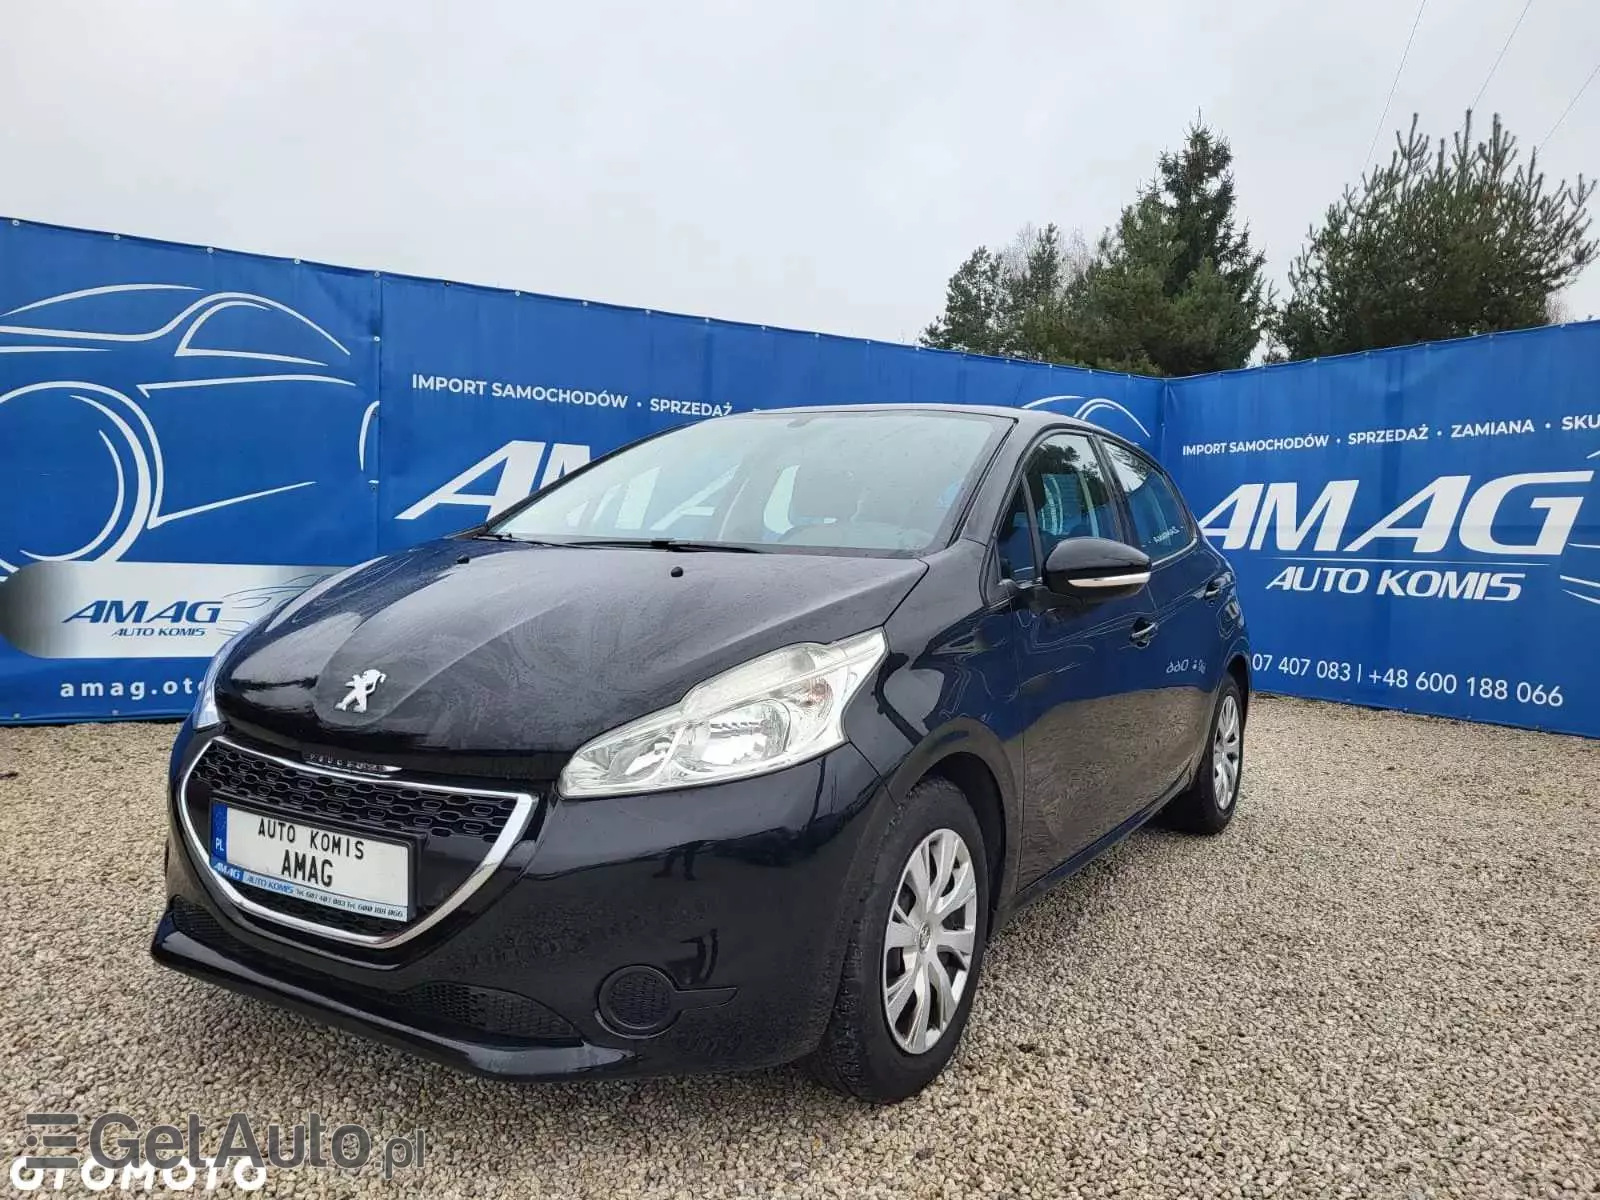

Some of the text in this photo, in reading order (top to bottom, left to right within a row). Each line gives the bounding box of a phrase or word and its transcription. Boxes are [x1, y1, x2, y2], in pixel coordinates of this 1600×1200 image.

[412, 373, 732, 417] IMPORT SAMOCHODÓW SPRZEDAŻ
[1182, 414, 1600, 456] IMPORT SAMOCHODÓW SPRZEDAŻ ZAMIANA SKU
[1265, 566, 1526, 601] AUTO KOMIS
[112, 627, 208, 637] AUTO KOMIS
[1278, 656, 1311, 677] 407
[1316, 660, 1351, 682] 083
[1368, 668, 1408, 689] +48
[1416, 671, 1458, 695] 600
[1466, 675, 1508, 701] 188
[1516, 681, 1565, 708] 066
[215, 837, 225, 851] PL
[258, 817, 365, 861] AUTO KOMIS
[281, 849, 334, 888] AMAG
